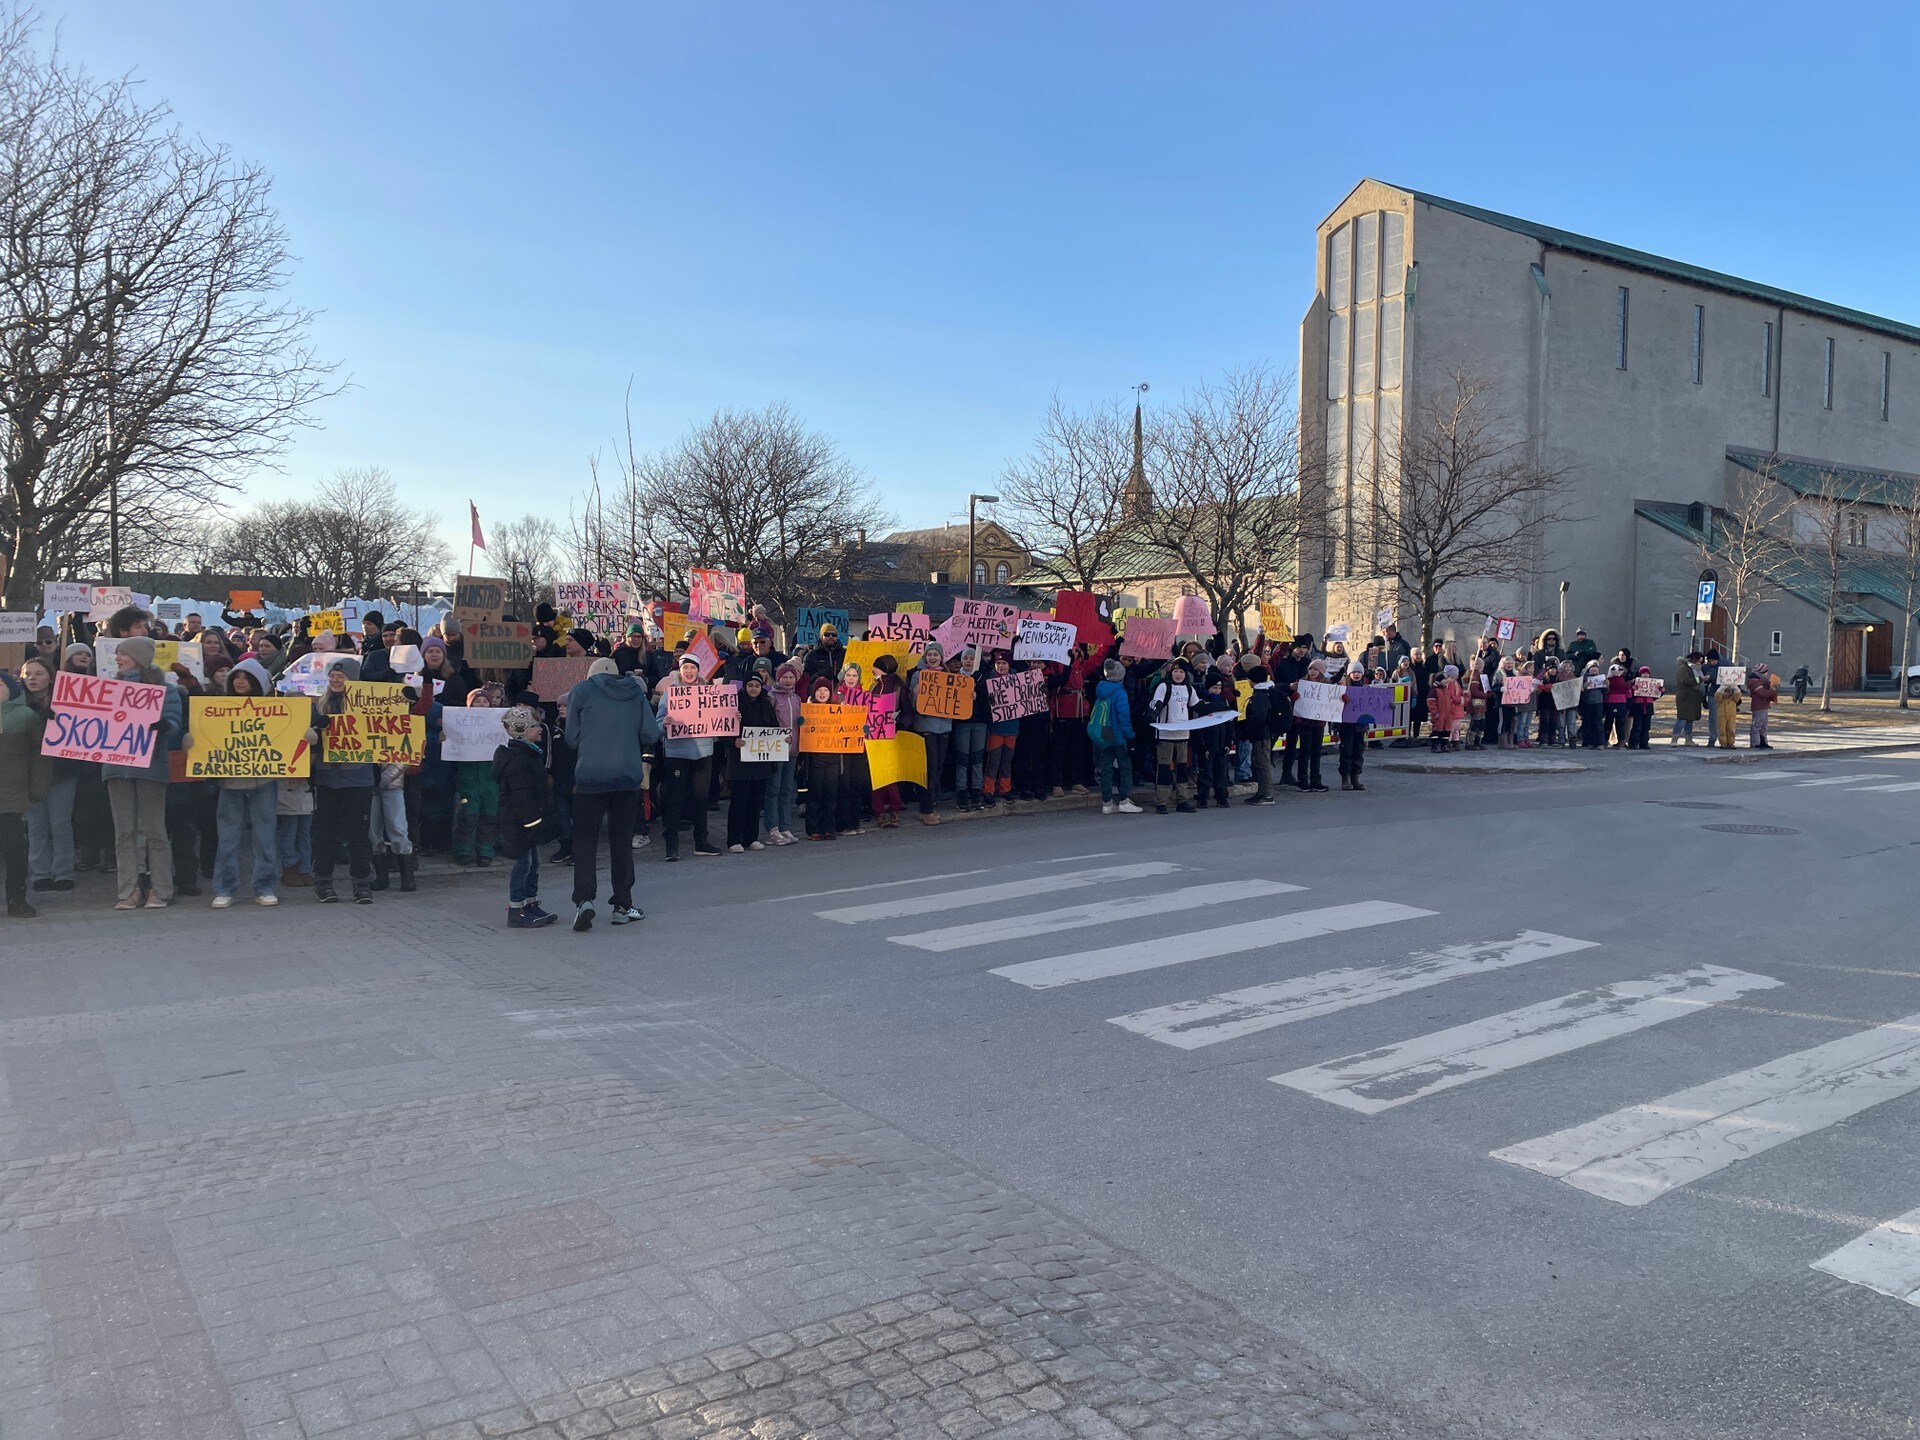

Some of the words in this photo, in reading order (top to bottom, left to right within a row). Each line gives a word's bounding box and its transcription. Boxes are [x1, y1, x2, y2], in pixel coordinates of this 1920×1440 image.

[559, 586, 591, 599] BARN
[1702, 584, 1711, 601] P
[91, 595, 133, 607] UNSTAD
[962, 601, 979, 616] IKKE
[887, 612, 913, 629] LA
[480, 623, 512, 638] REDD
[803, 629, 819, 644] LEV
[963, 631, 1000, 646] MITT!
[471, 641, 531, 660] HUNSTAD
[921, 671, 940, 684] IKKE
[56, 675, 119, 706] IKKE
[119, 686, 163, 711] RØR
[669, 686, 692, 697] IKKE
[697, 685, 720, 696] LEGG
[920, 682, 942, 697] DET
[946, 687, 958, 700] ER
[204, 706, 242, 717] SLUTT
[253, 705, 288, 718] TULL
[361, 706, 392, 715] 2024
[669, 698, 691, 711] NED
[829, 706, 843, 714] LA
[923, 696, 961, 716] ALLE
[230, 717, 266, 734] LIGG
[326, 715, 359, 736] HAR
[365, 714, 412, 735] IKKE
[455, 714, 486, 727] REDD
[45, 712, 153, 757] SKOLAN
[459, 732, 506, 746] HUNSTA
[743, 728, 755, 739] LA
[224, 733, 272, 751] UNNA
[367, 735, 395, 750] TIL
[749, 738, 782, 753] LEVE
[207, 748, 283, 763] HUNSTAD
[328, 749, 374, 763] DRIVE
[758, 752, 770, 761] !!!
